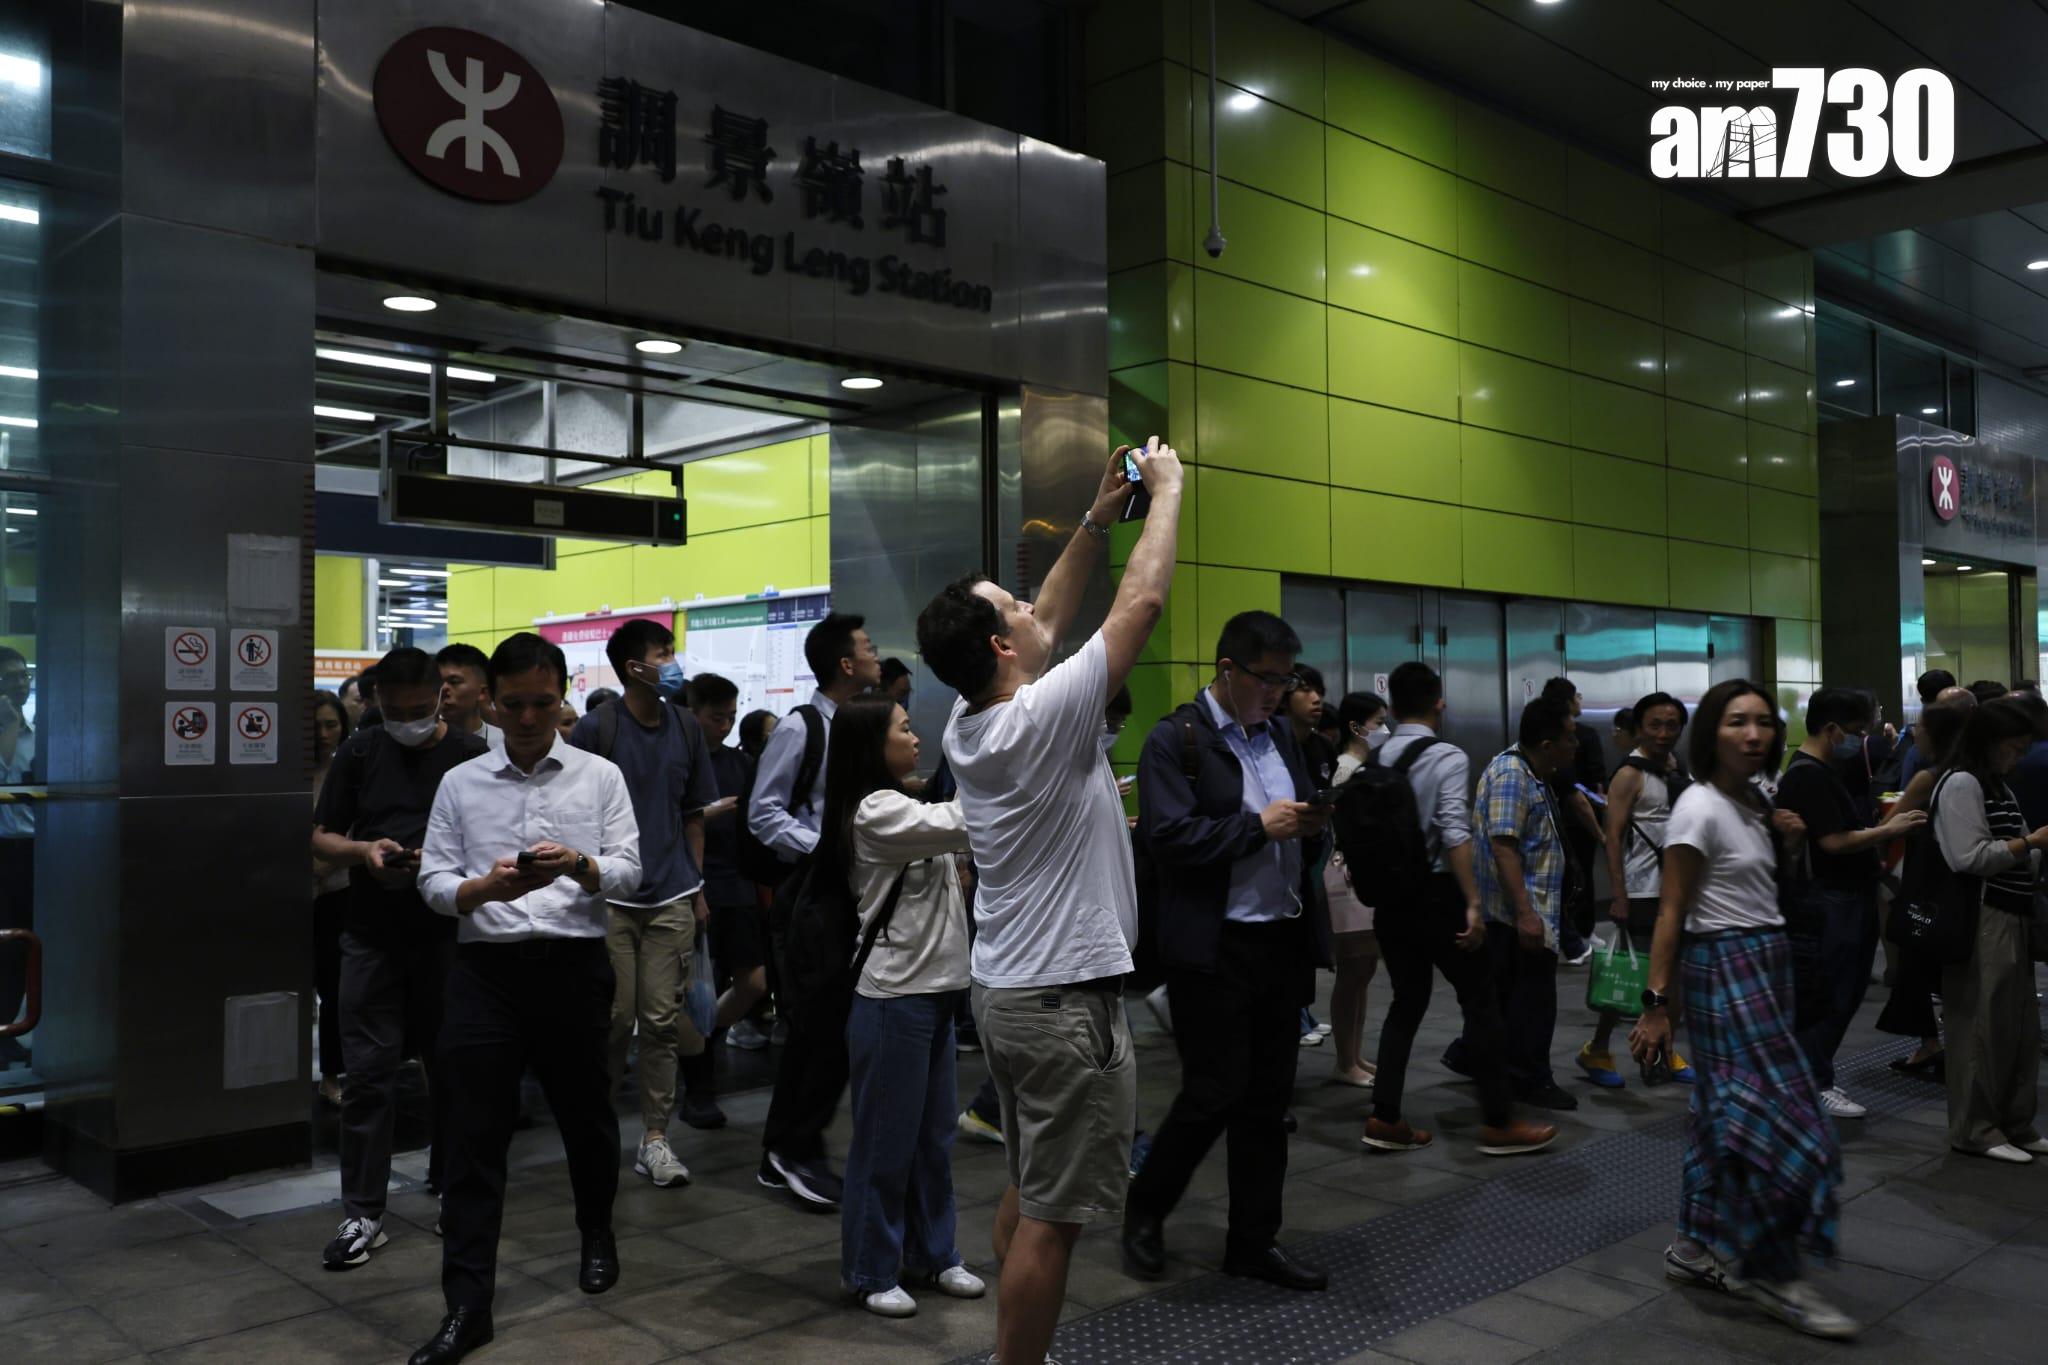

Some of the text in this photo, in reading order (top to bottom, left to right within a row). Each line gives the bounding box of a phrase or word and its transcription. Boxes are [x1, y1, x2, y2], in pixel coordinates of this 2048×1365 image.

[598, 76, 948, 248] 調景嶺站
[598, 186, 993, 313] Tiu Keng Leng Station
